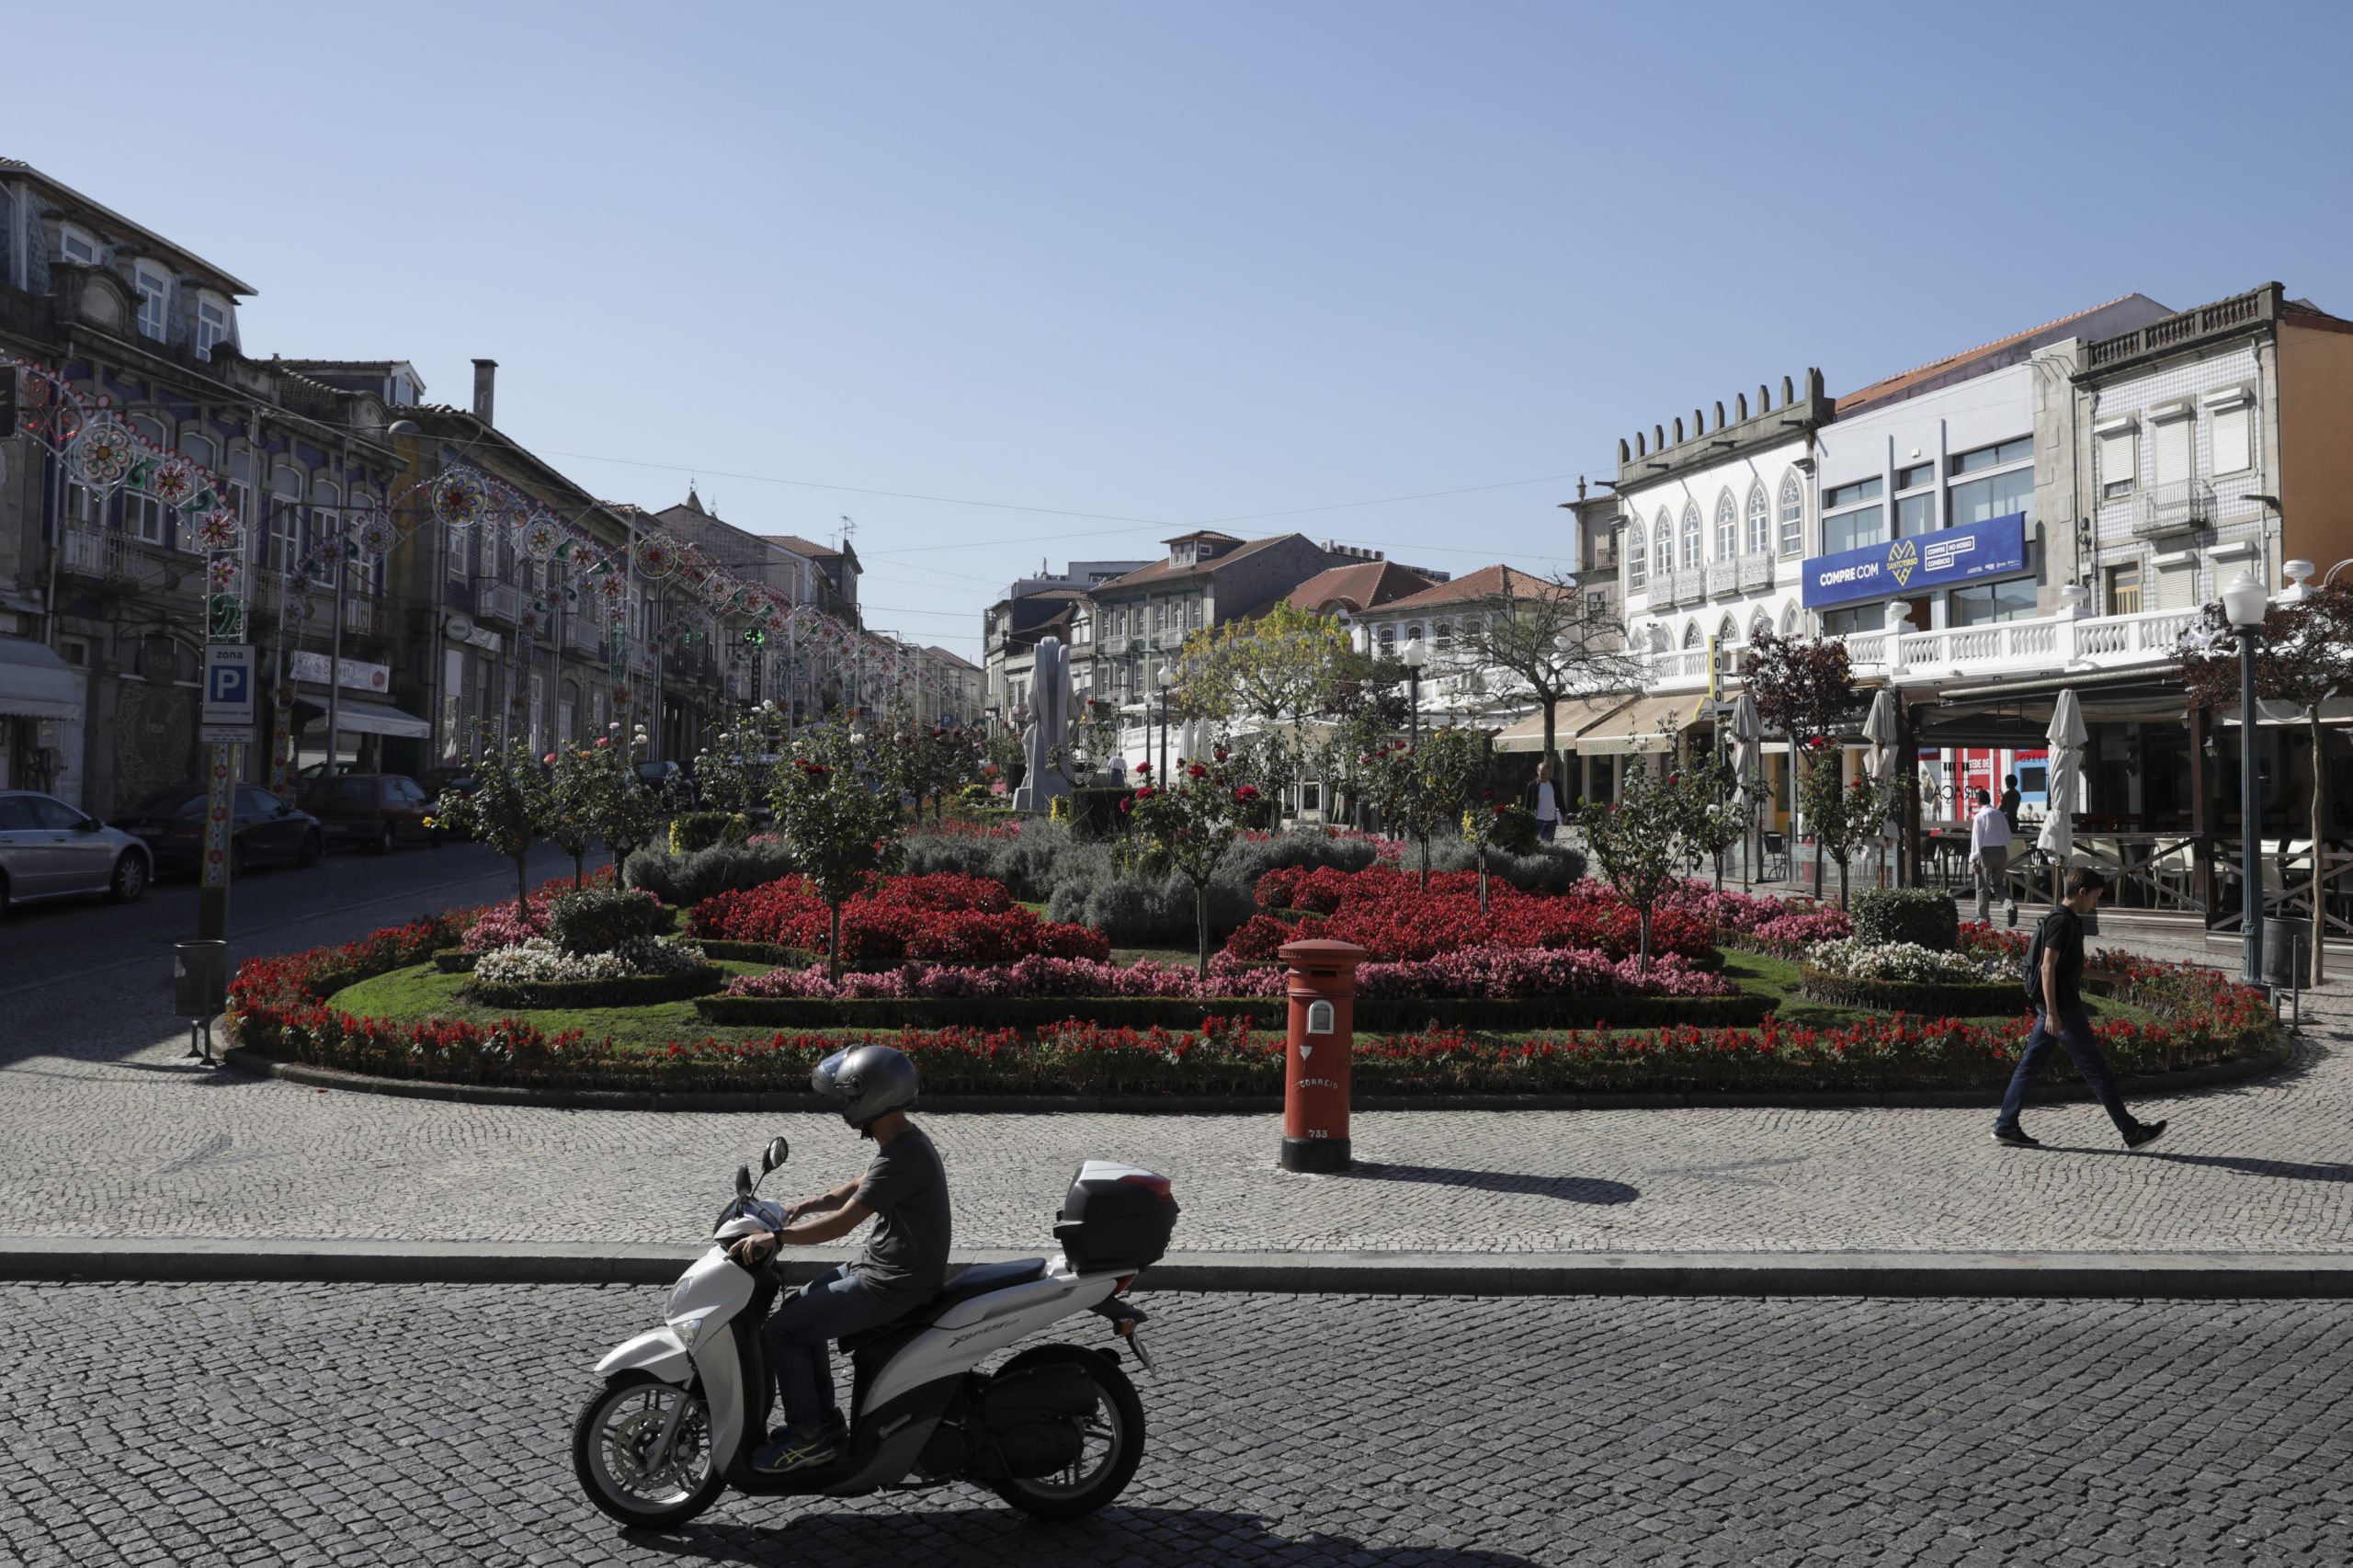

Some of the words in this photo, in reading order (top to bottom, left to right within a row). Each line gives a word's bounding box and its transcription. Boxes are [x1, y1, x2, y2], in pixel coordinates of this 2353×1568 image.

[1820, 567, 1855, 586] COMPRE
[1857, 562, 1879, 579] COM
[216, 651, 244, 660] zona
[324, 659, 356, 679] BNTO
[216, 668, 241, 699] P
[1968, 758, 1982, 769] SEDE
[1300, 1078, 1338, 1089] CORREIO
